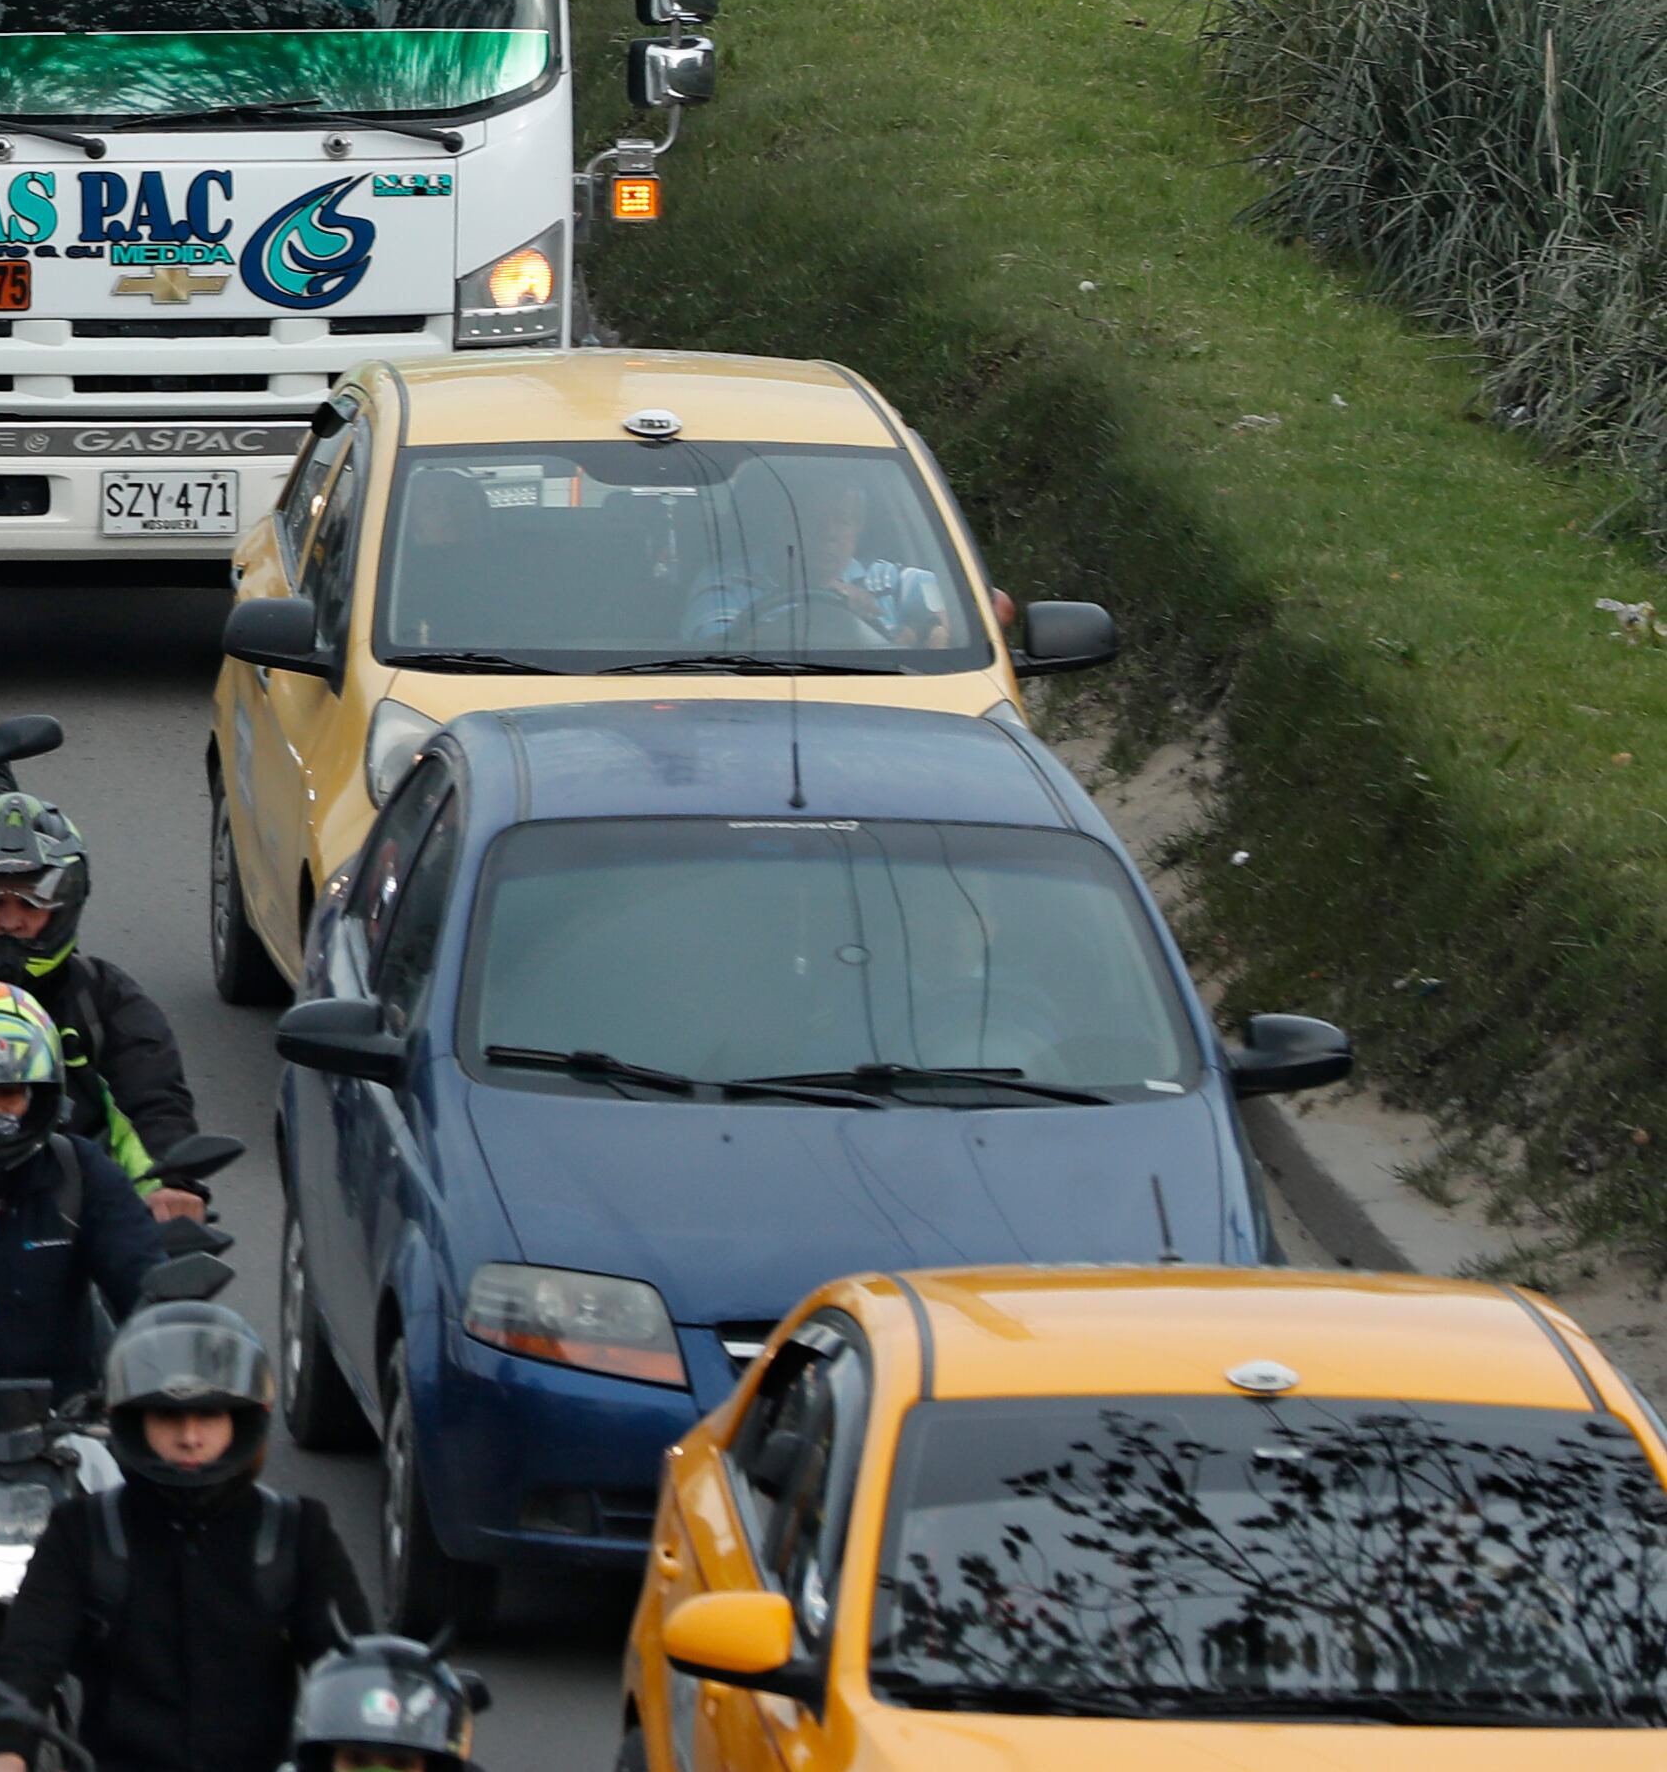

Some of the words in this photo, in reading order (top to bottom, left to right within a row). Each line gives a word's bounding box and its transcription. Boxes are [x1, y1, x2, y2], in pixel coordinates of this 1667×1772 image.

[76, 169, 235, 244] P.A.C
[110, 243, 236, 266] MEDIDA
[73, 429, 269, 453] GASPAC
